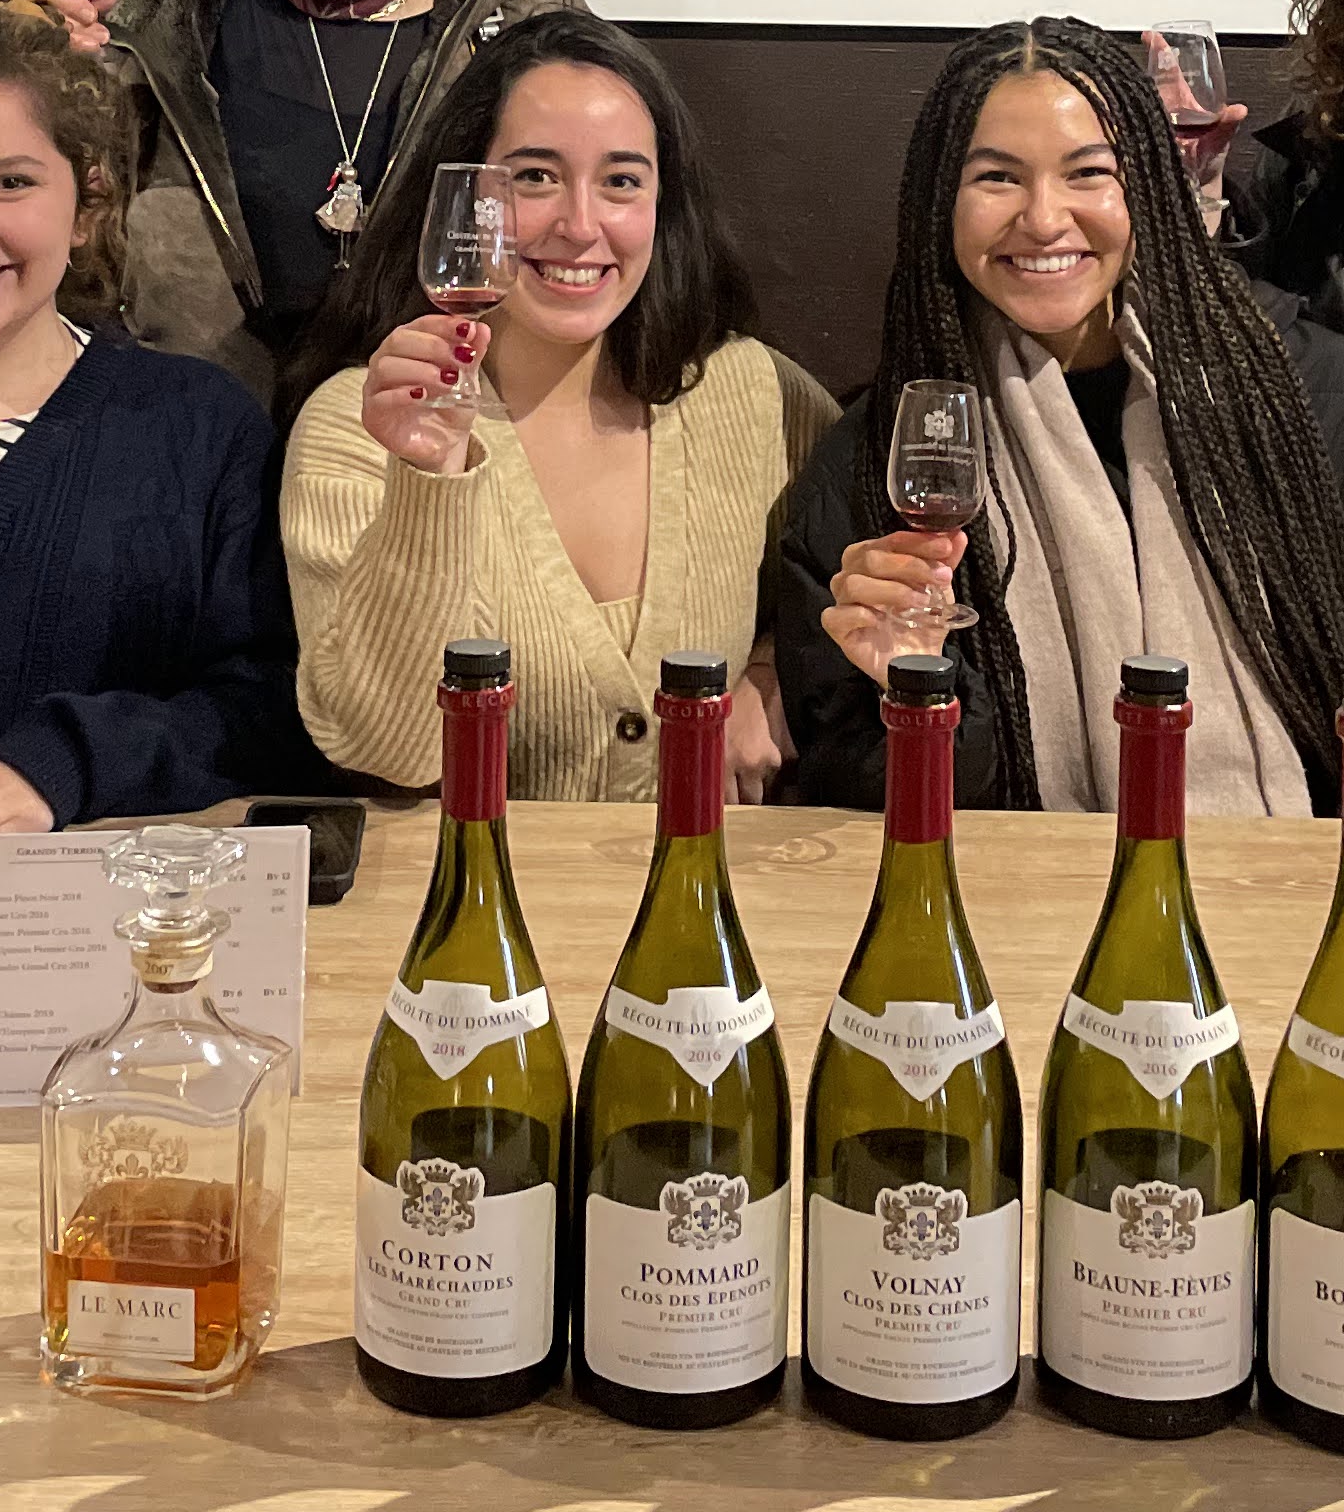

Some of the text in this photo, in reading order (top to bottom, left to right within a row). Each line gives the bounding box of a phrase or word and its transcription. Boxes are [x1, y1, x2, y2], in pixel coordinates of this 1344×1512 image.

[144, 961, 175, 976] 2007
[437, 1016, 460, 1029] DU
[622, 1005, 684, 1034] RÉCOLTE
[690, 1022, 713, 1035] DU
[1078, 1012, 1139, 1045] RÉCOLTE
[1145, 1035, 1168, 1048] DU
[842, 1014, 901, 1048] RÉCOLTE
[906, 1037, 929, 1049] DU
[688, 1049, 722, 1062] 2016
[903, 1063, 938, 1077] 2016
[1143, 1062, 1177, 1076] 2016
[382, 1239, 494, 1272] CORTON
[368, 1256, 387, 1278] LES
[640, 1258, 759, 1286] POMMARD
[621, 1277, 771, 1306] CLOS DES EPENOTS
[871, 1269, 966, 1296] VOLNAY
[80, 1295, 183, 1319] LE MARC
[398, 1290, 441, 1308] GRAND
[445, 1297, 472, 1308] CRU
[843, 1289, 884, 1312] CLOS
[890, 1302, 922, 1316] DES
[1102, 1299, 1207, 1320] PREMIER CRU
[659, 1311, 715, 1323] PREMIER
[719, 1306, 743, 1320] CRU
[875, 1317, 962, 1332] PREMIER CRU
